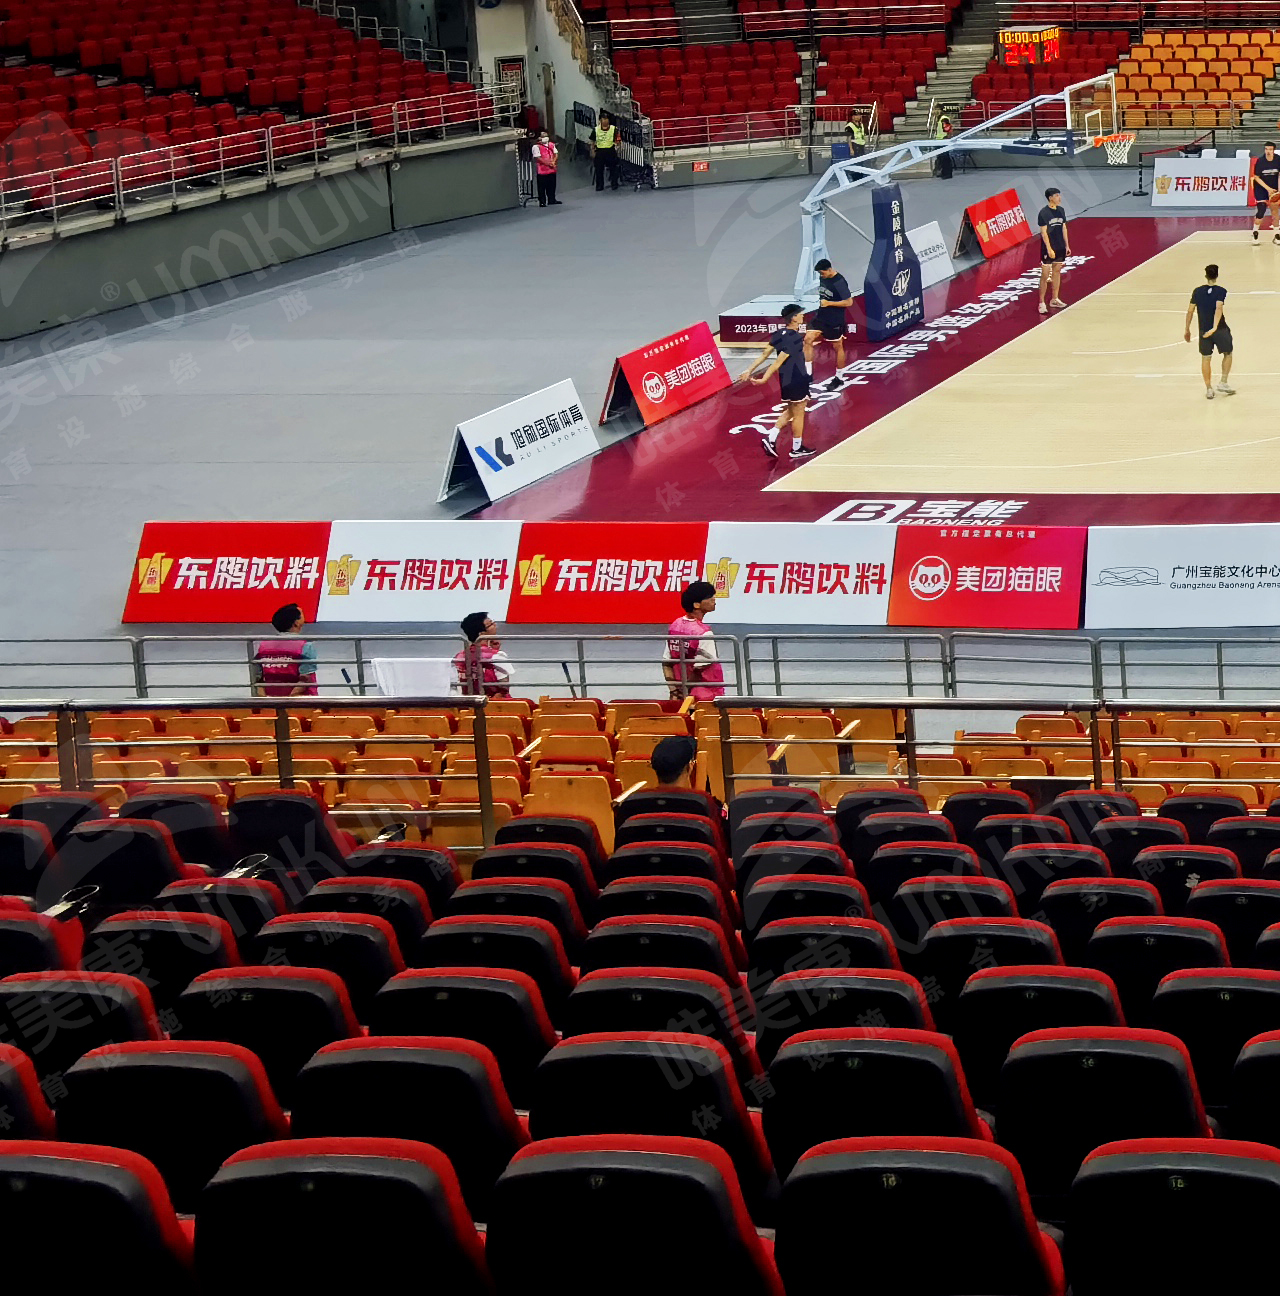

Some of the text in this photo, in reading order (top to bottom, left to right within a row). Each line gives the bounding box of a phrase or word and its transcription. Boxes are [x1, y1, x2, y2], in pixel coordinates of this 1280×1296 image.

[1004, 44, 1036, 65] 24
[1174, 175, 1247, 192] 东鹏饮料
[891, 200, 905, 264] 金陵体育
[986, 205, 1027, 237] 东鹏饮料
[663, 351, 717, 391] 美团猫眼
[511, 401, 584, 451] 旭励国际体育
[905, 499, 1029, 518] 宝能
[173, 556, 320, 591] 东鹏饮料
[365, 558, 510, 591] 东鹏饮料
[554, 559, 700, 592] 东鹏饮料
[745, 560, 887, 595] 东鹏饮料
[956, 565, 1062, 593] 美团猫眼
[1170, 580, 1216, 590] Guangzhou
[1219, 580, 1254, 590] Baoneng
